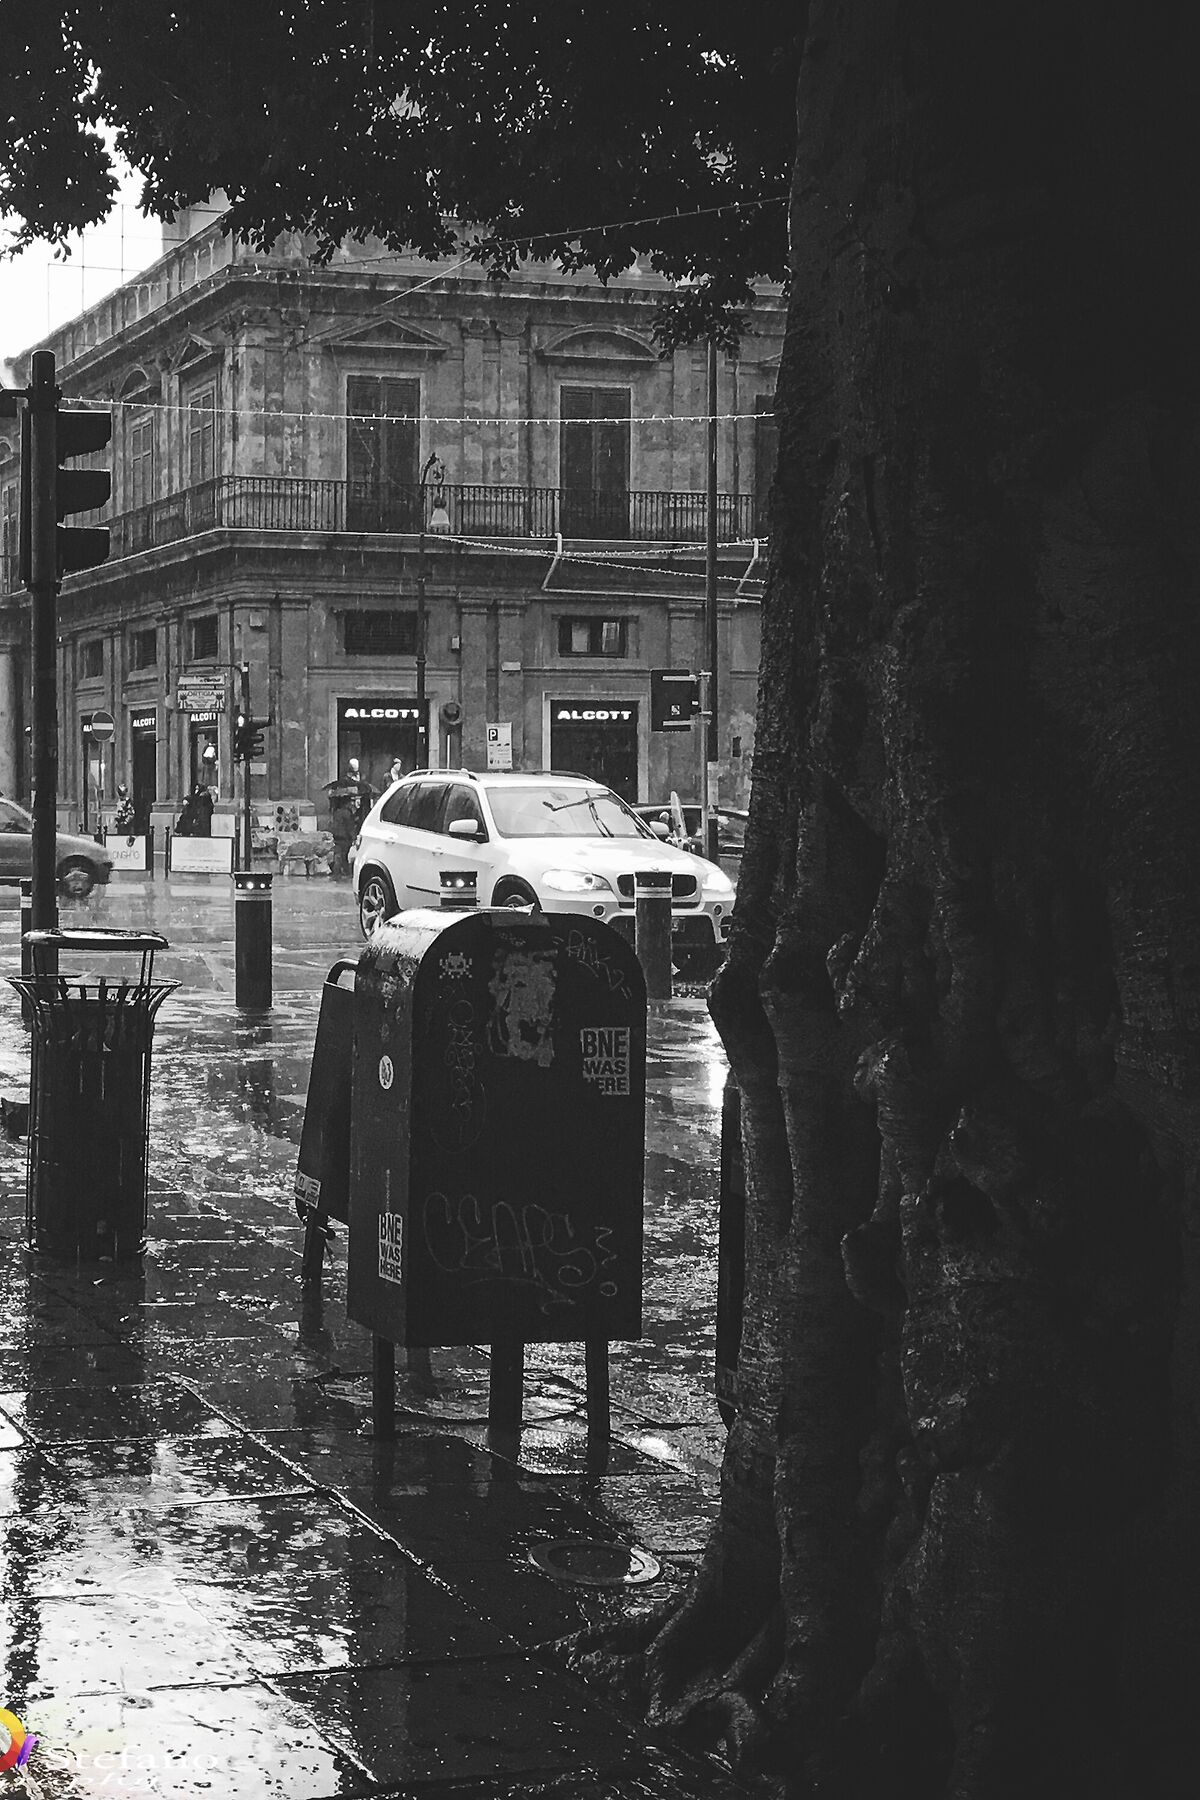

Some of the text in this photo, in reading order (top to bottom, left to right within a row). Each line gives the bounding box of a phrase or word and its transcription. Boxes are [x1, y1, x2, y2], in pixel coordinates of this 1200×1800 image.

[190, 712, 216, 722] ALCOTT
[344, 708, 419, 719] ALCOTT
[557, 709, 632, 721] ALCOTT
[132, 717, 156, 727] ALCOTT
[582, 1030, 628, 1058] BNE
[584, 1060, 626, 1075] WAS
[585, 1077, 628, 1092] ERE
[380, 1214, 402, 1246] BNE
[380, 1241, 401, 1263] WAS
[380, 1258, 402, 1280] HERE
